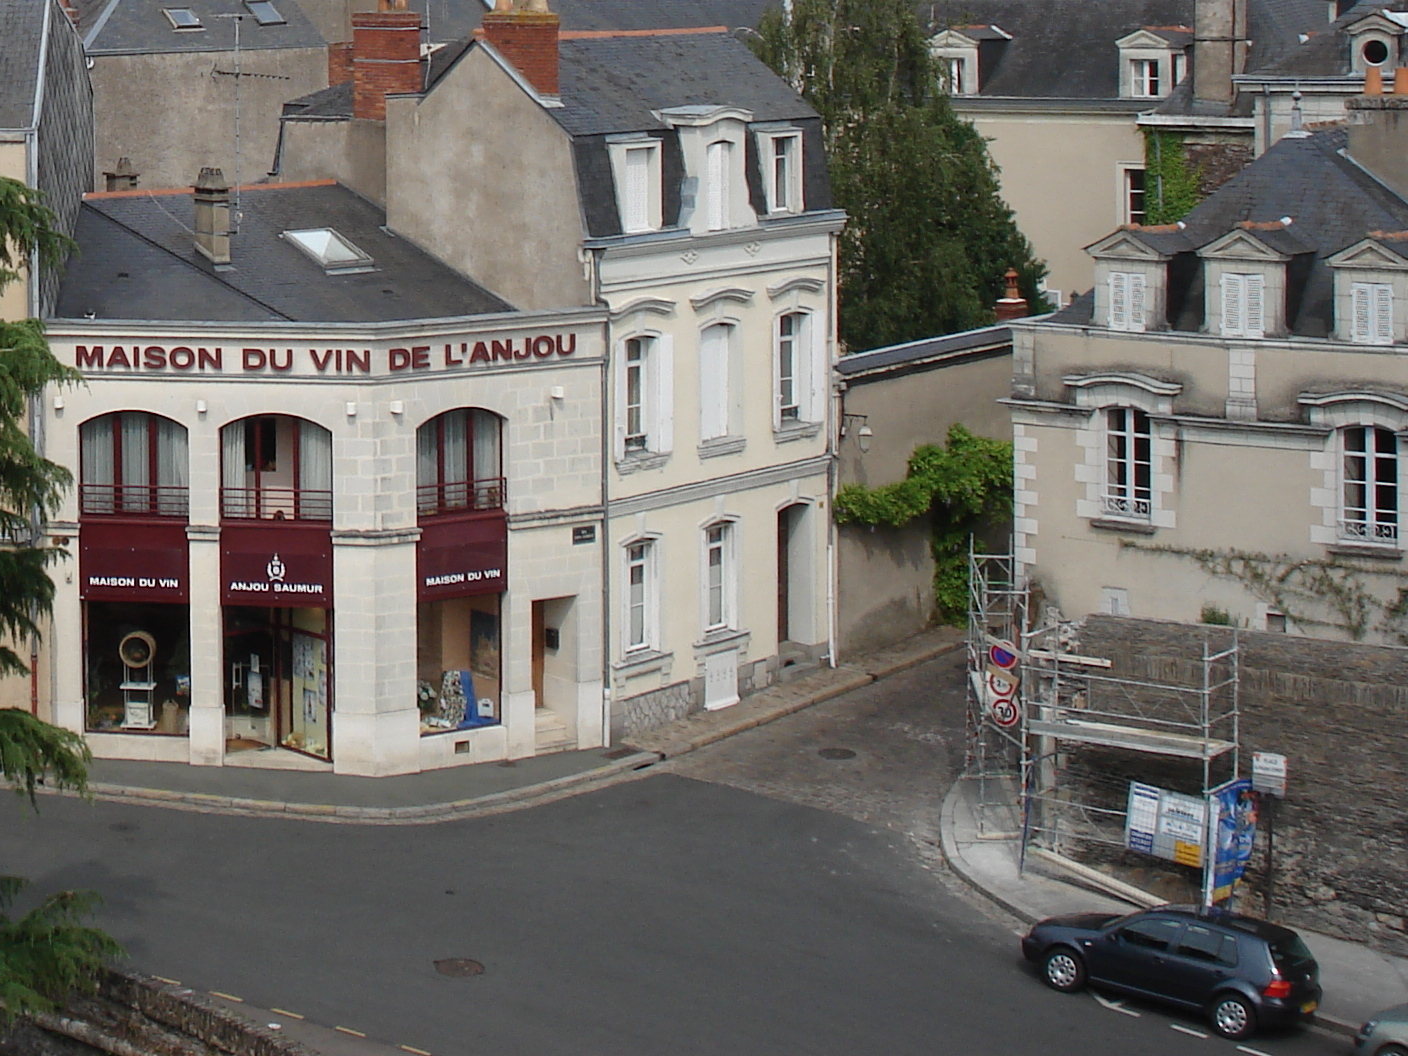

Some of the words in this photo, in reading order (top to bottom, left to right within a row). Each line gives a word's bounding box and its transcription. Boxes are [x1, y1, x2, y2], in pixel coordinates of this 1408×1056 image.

[75, 345, 222, 370] MAISON
[242, 348, 293, 371] DU
[309, 349, 371, 372] VIN
[389, 345, 430, 372] DE
[445, 333, 576, 367] L'ANJOU
[89, 576, 135, 587] MAISON
[139, 578, 156, 588] DU
[159, 578, 179, 588] VIN
[425, 573, 465, 587] MAISON
[467, 570, 482, 581] DU
[484, 568, 501, 579] VIN
[230, 582, 269, 592] ANJOU
[274, 583, 323, 594] SAUMUR
